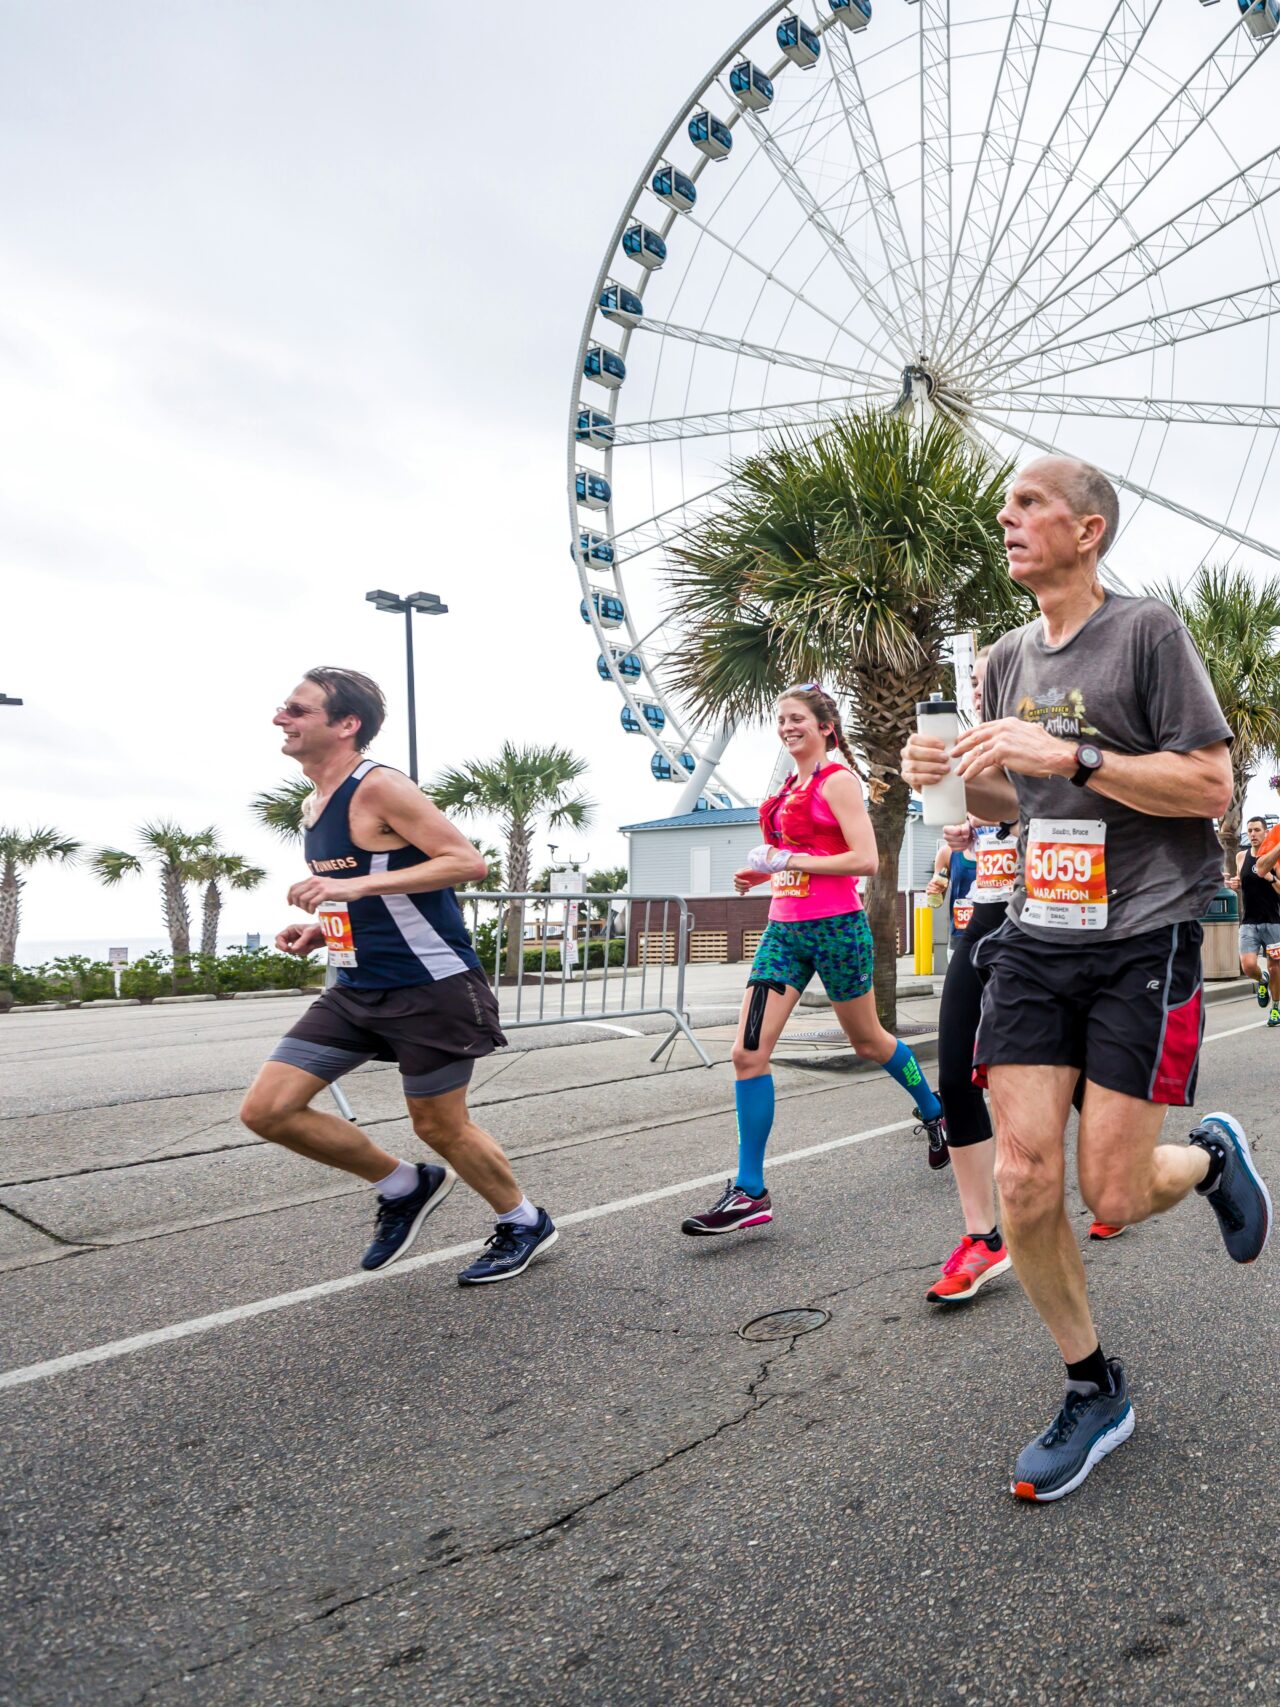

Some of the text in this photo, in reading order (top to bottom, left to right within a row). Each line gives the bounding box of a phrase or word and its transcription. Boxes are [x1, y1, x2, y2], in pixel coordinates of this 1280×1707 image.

[1045, 715, 1080, 735] ATHON
[1072, 828, 1088, 836] Bruce
[312, 857, 357, 873] RUNNERS
[978, 853, 1015, 876] 5326
[1031, 848, 1092, 883] 5059
[1033, 887, 1089, 901] MARATHON
